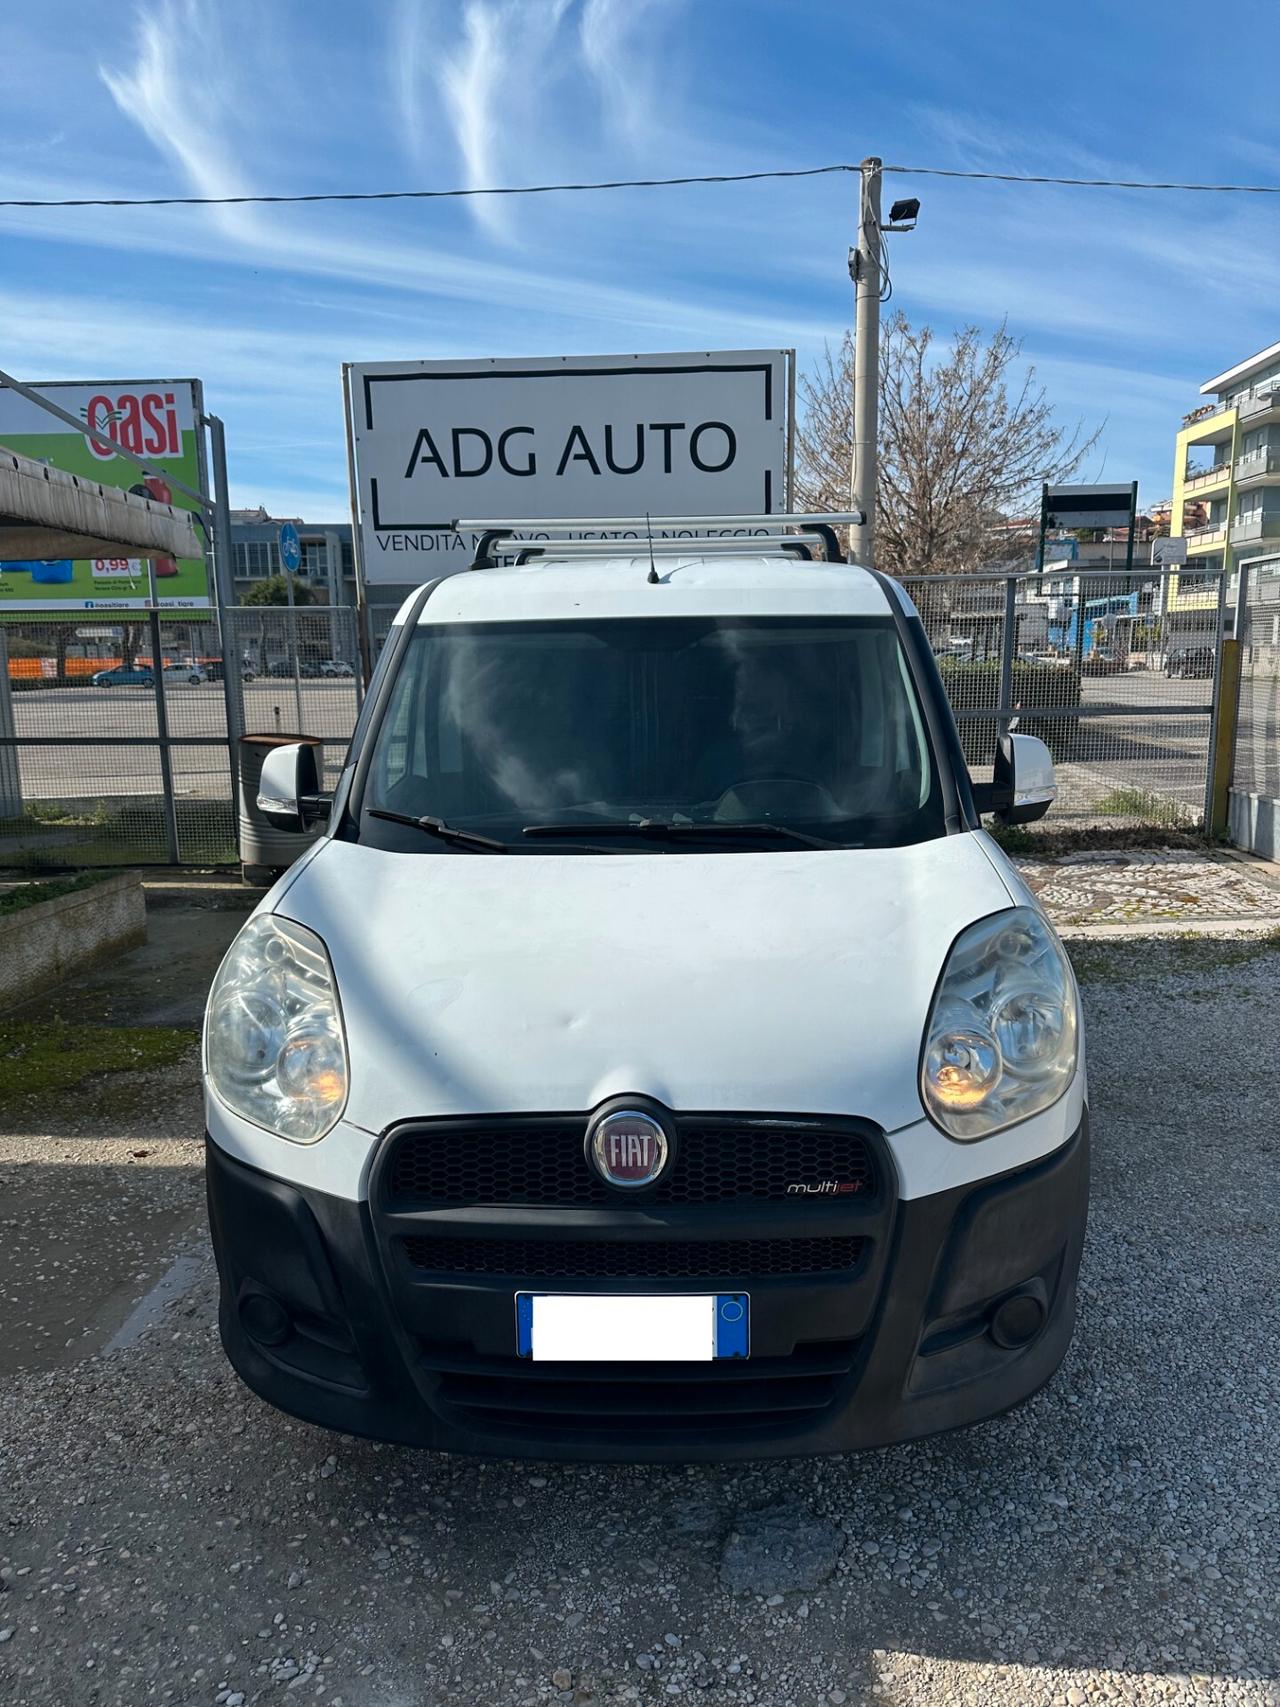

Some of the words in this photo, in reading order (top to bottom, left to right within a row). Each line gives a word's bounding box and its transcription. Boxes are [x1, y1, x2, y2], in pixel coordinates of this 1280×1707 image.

[404, 426, 537, 479] ADG
[555, 421, 738, 476] AUTO
[95, 559, 128, 573] 0,99
[610, 1134, 652, 1168] FIAT
[786, 1180, 864, 1196] multijet
